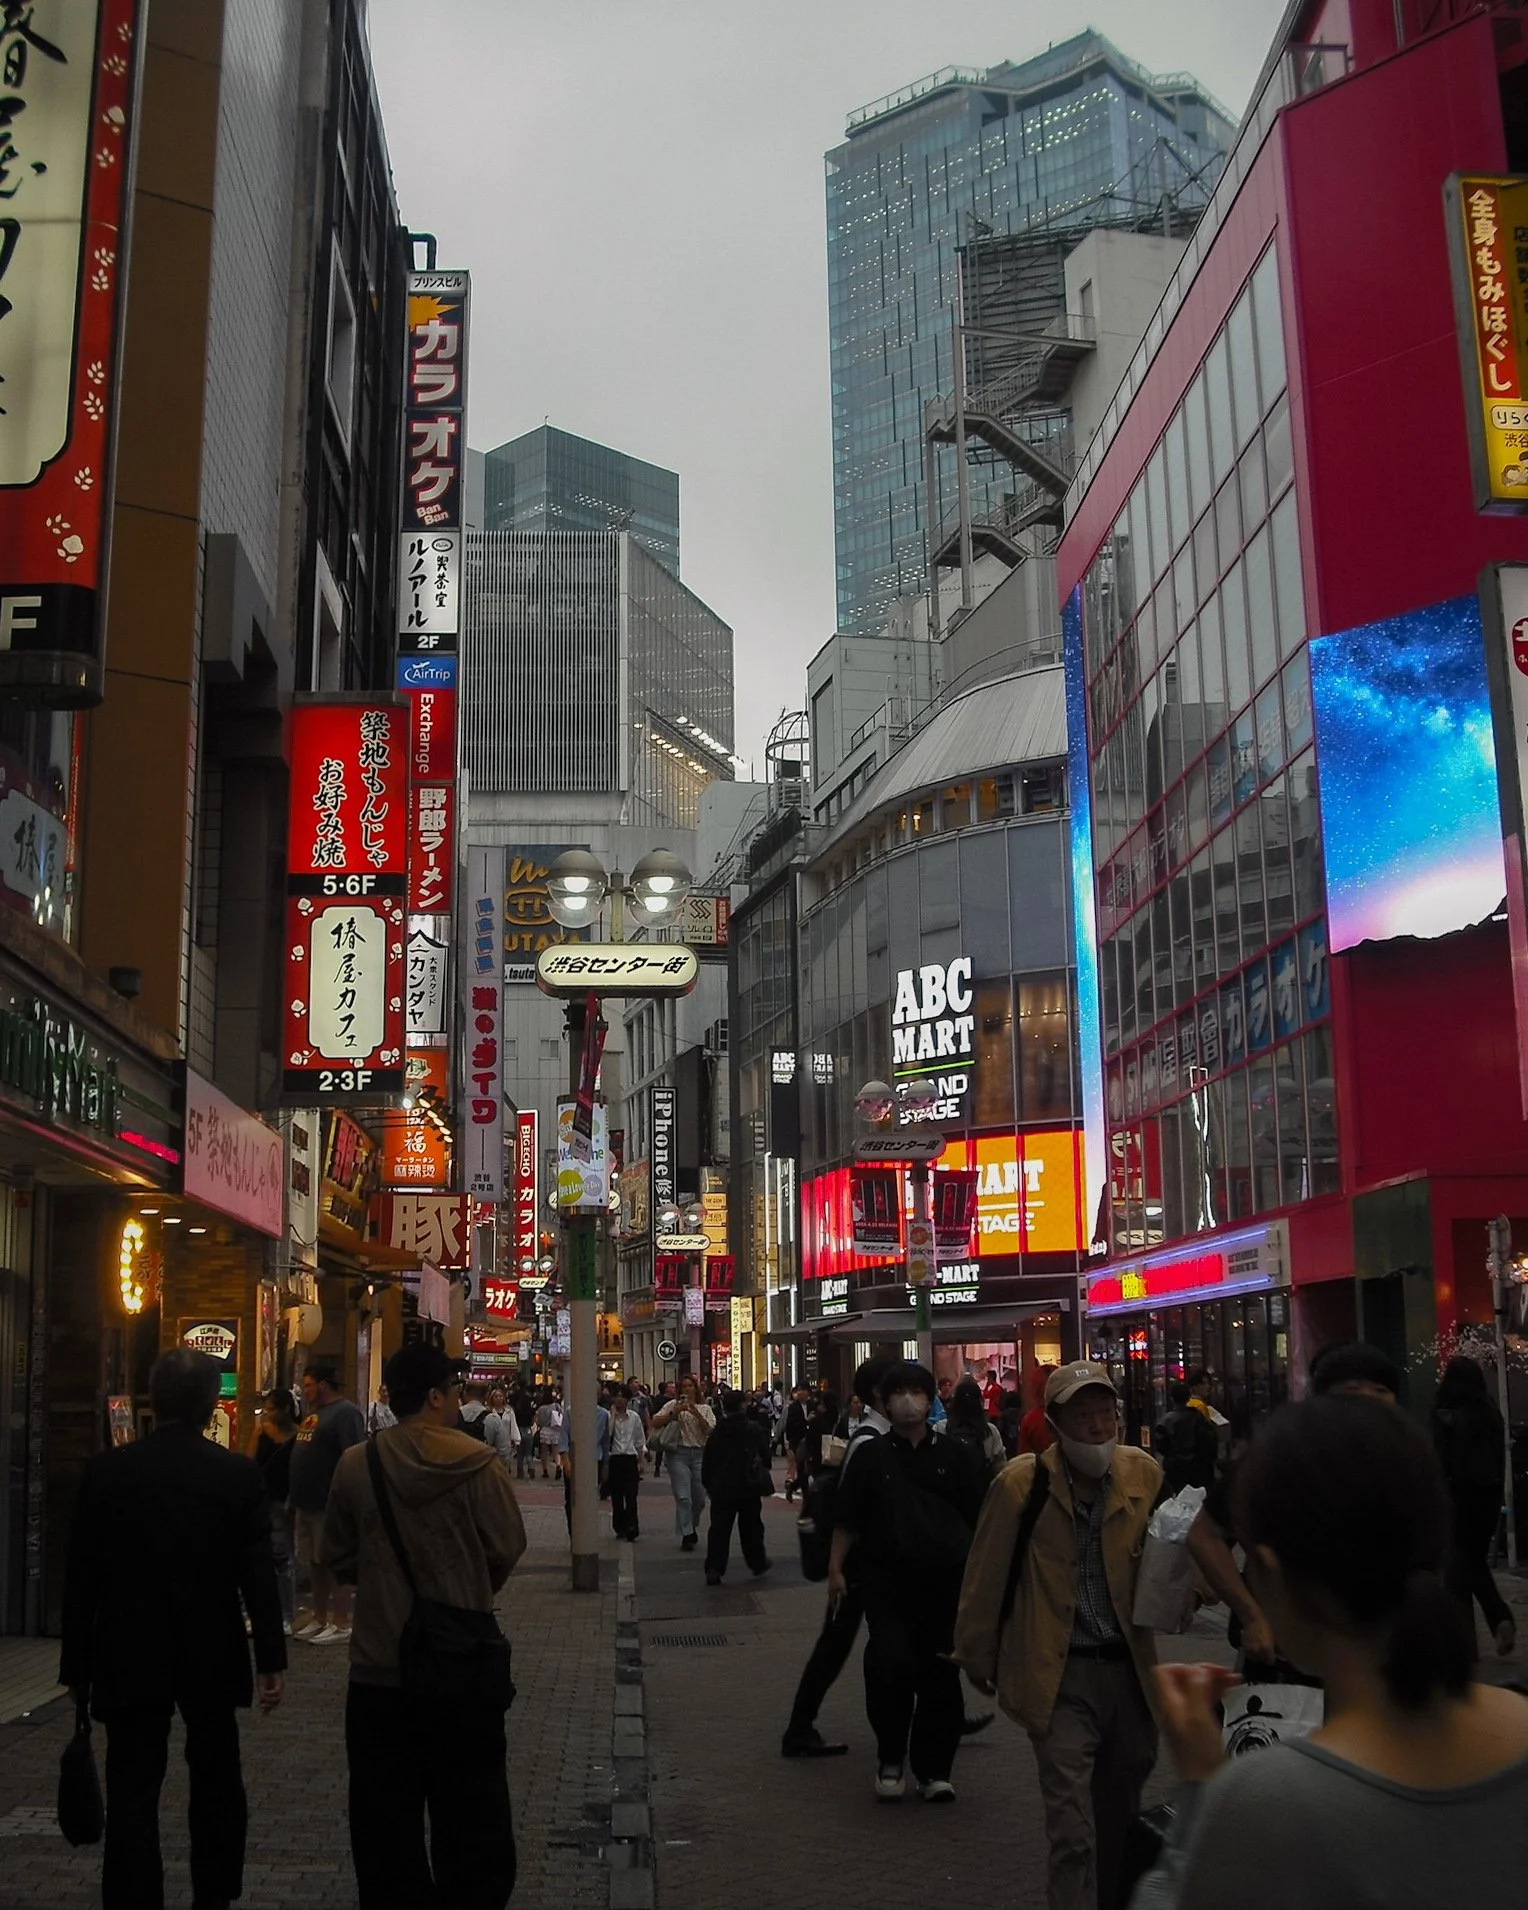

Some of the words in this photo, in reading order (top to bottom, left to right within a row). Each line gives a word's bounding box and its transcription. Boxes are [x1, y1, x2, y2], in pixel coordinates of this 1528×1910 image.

[413, 276, 462, 288] プリンスビル
[1469, 188, 1512, 392] 全身もみほぐし
[411, 319, 458, 501] カラオケ
[416, 502, 442, 518] Ban
[424, 510, 449, 527] Ban
[407, 538, 429, 629] ルノアール
[417, 635, 440, 649] 2F
[413, 668, 451, 682] AirTrip
[415, 692, 435, 774] Exchange
[311, 757, 348, 868] お好み焼
[359, 711, 391, 868] 築地もんじゃ
[418, 787, 447, 908] 野郎ラーメン
[330, 916, 367, 1047] 椿屋カフェ
[408, 956, 426, 1025] カンダヤ
[544, 956, 689, 975] 渋谷センター街
[892, 956, 973, 1026] ABC
[1226, 940, 1326, 1056] カラオケ
[892, 1014, 975, 1065] MART
[896, 1073, 968, 1104] GND
[188, 1108, 203, 1156] 5F
[558, 1148, 604, 1162] Weme
[859, 1139, 939, 1152] 渋谷センター街
[390, 1195, 460, 1266] 豚
[909, 1292, 944, 1306] GND
[945, 1290, 978, 1304] STAGE
